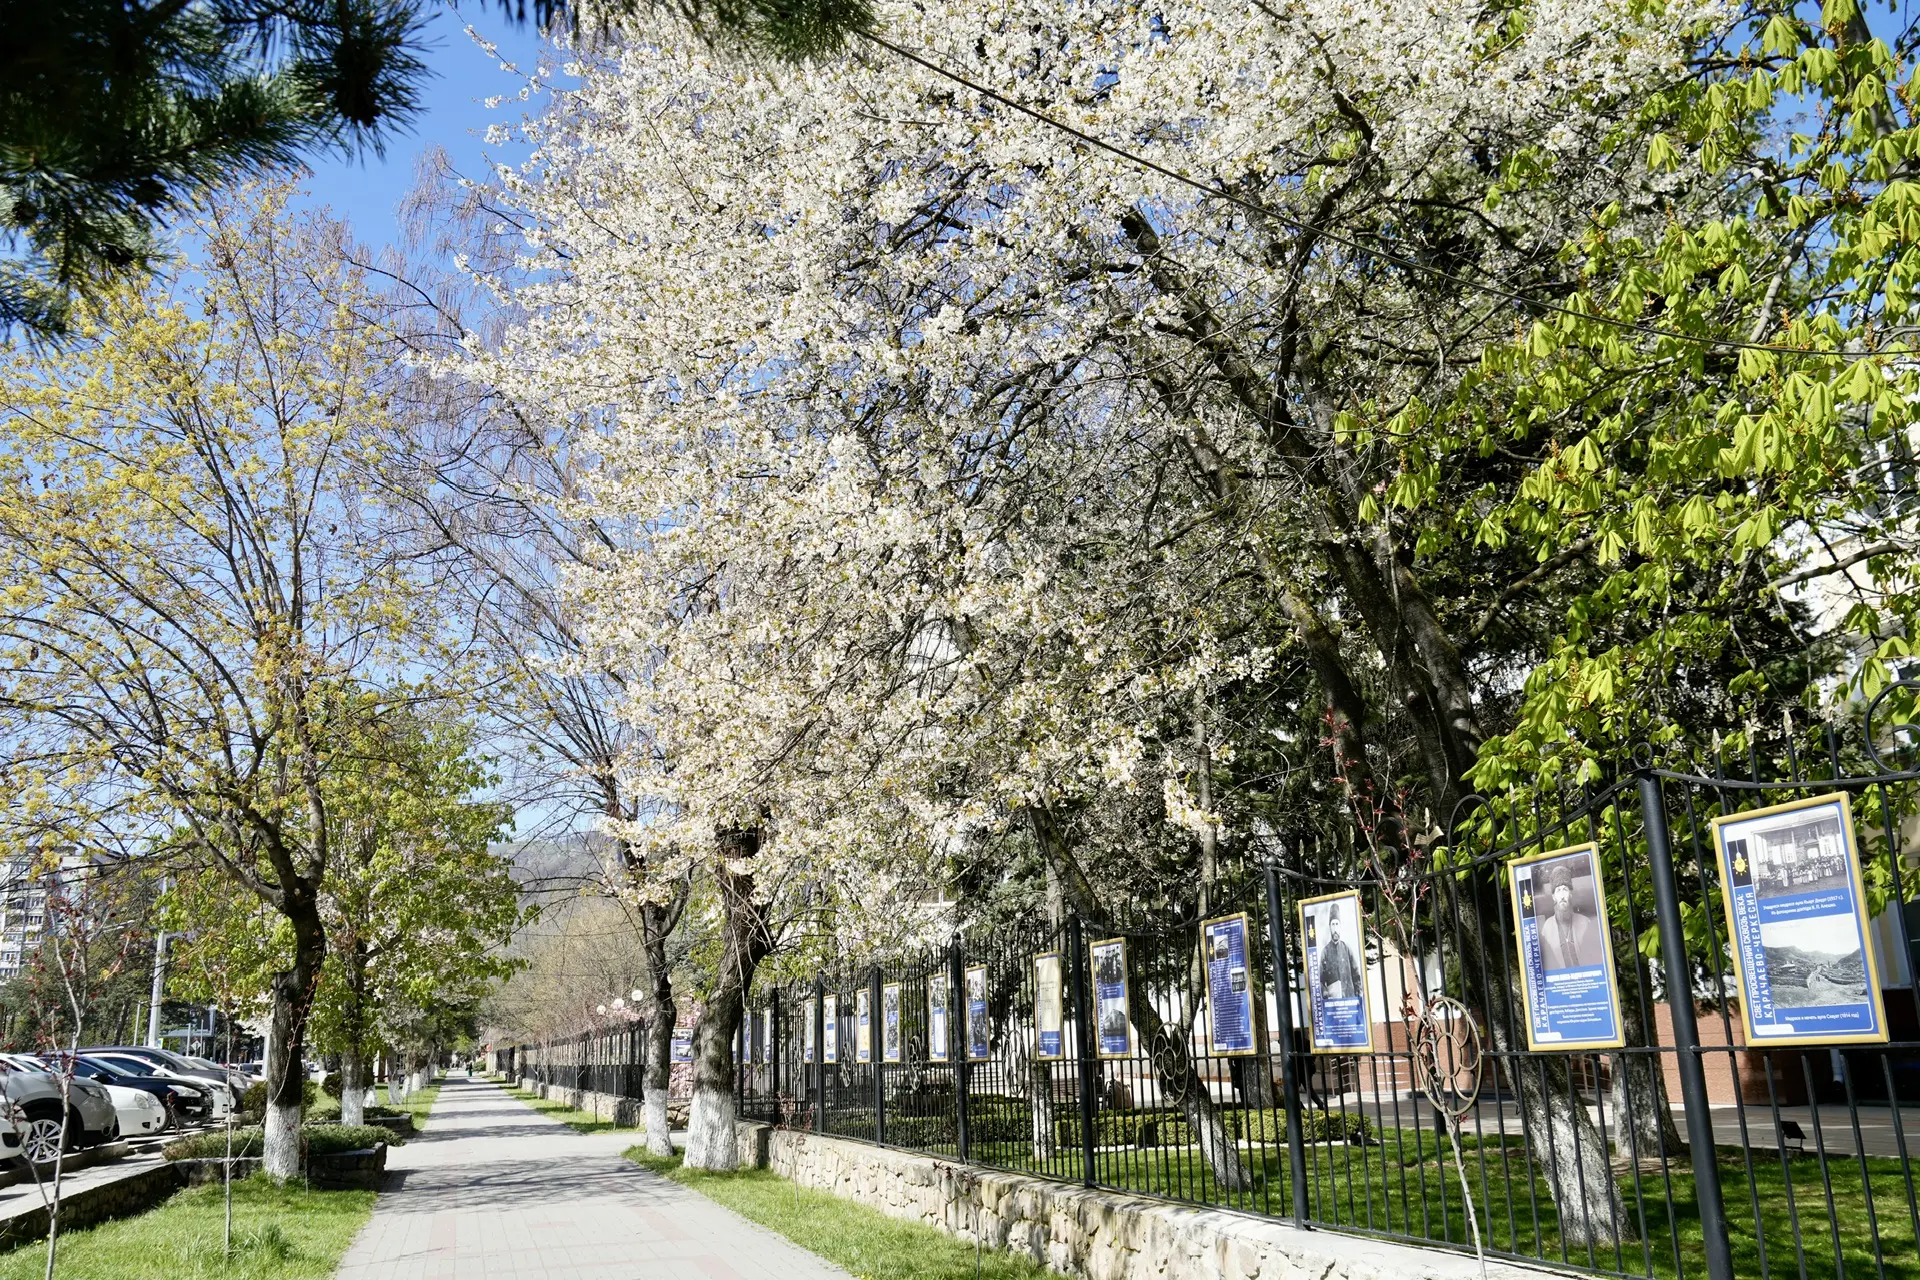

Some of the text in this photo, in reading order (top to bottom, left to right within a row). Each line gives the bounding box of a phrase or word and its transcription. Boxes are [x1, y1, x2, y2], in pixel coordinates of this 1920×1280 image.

[1530, 923, 1548, 1028] КАРАЧАЕВО-ЧЕРКЕСИЯ
[1736, 893, 1762, 1018] СВЕТ ПРОСВЕЩЕНИЯ СКВОЗЬ ВЕКА:
[1745, 892, 1773, 1018] КАРАЧАЕВО-ЧЕРКЕСИЯ
